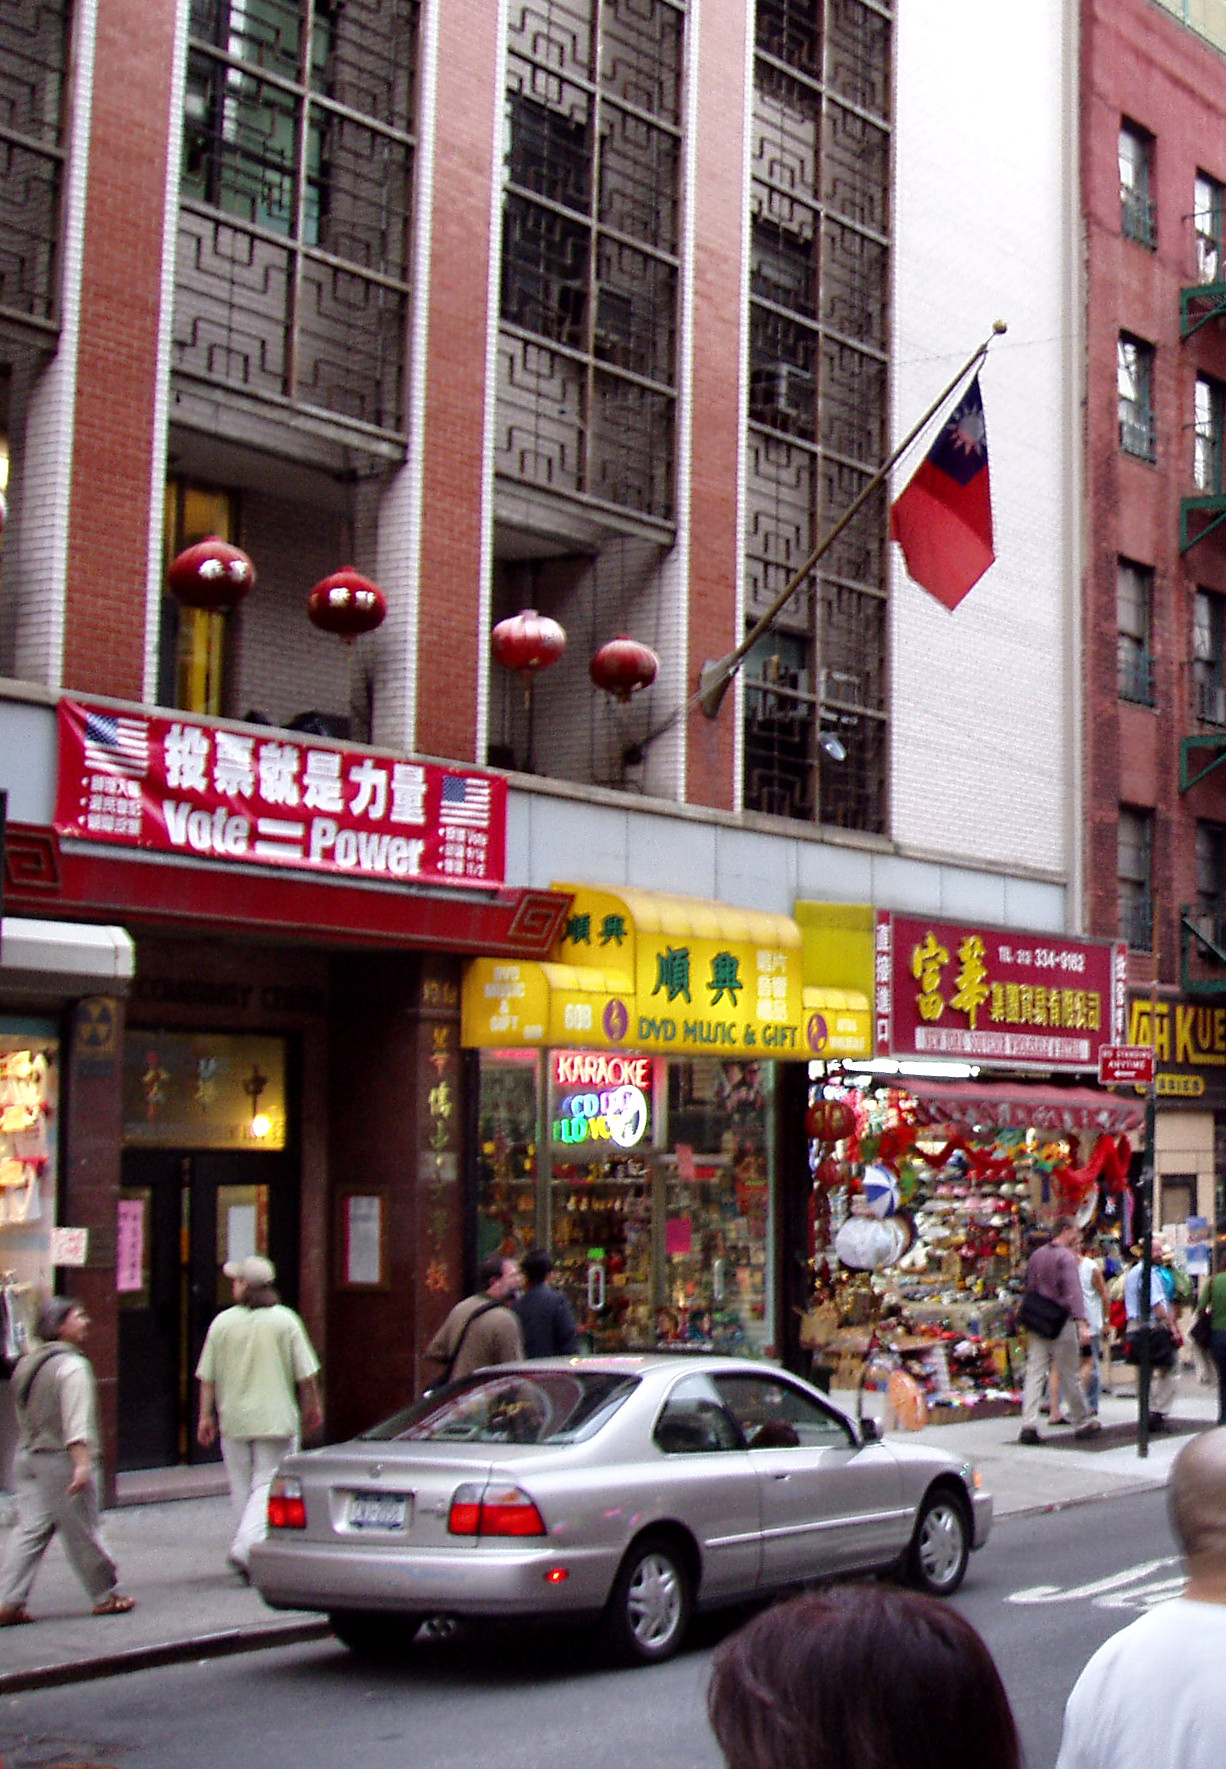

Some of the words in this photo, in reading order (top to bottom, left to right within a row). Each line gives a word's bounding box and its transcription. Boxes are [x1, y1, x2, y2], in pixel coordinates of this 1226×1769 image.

[163, 722, 428, 826] 投票就是力量
[162, 799, 249, 854] Vote
[308, 816, 425, 875] Power
[651, 944, 743, 1008] 順興
[637, 1015, 677, 1041] DVD
[682, 1018, 737, 1045] MUSIC
[762, 1025, 799, 1049] GIFT
[557, 1055, 651, 1089] KARAOKE
[1107, 1060, 1146, 1070] ANYTIME
